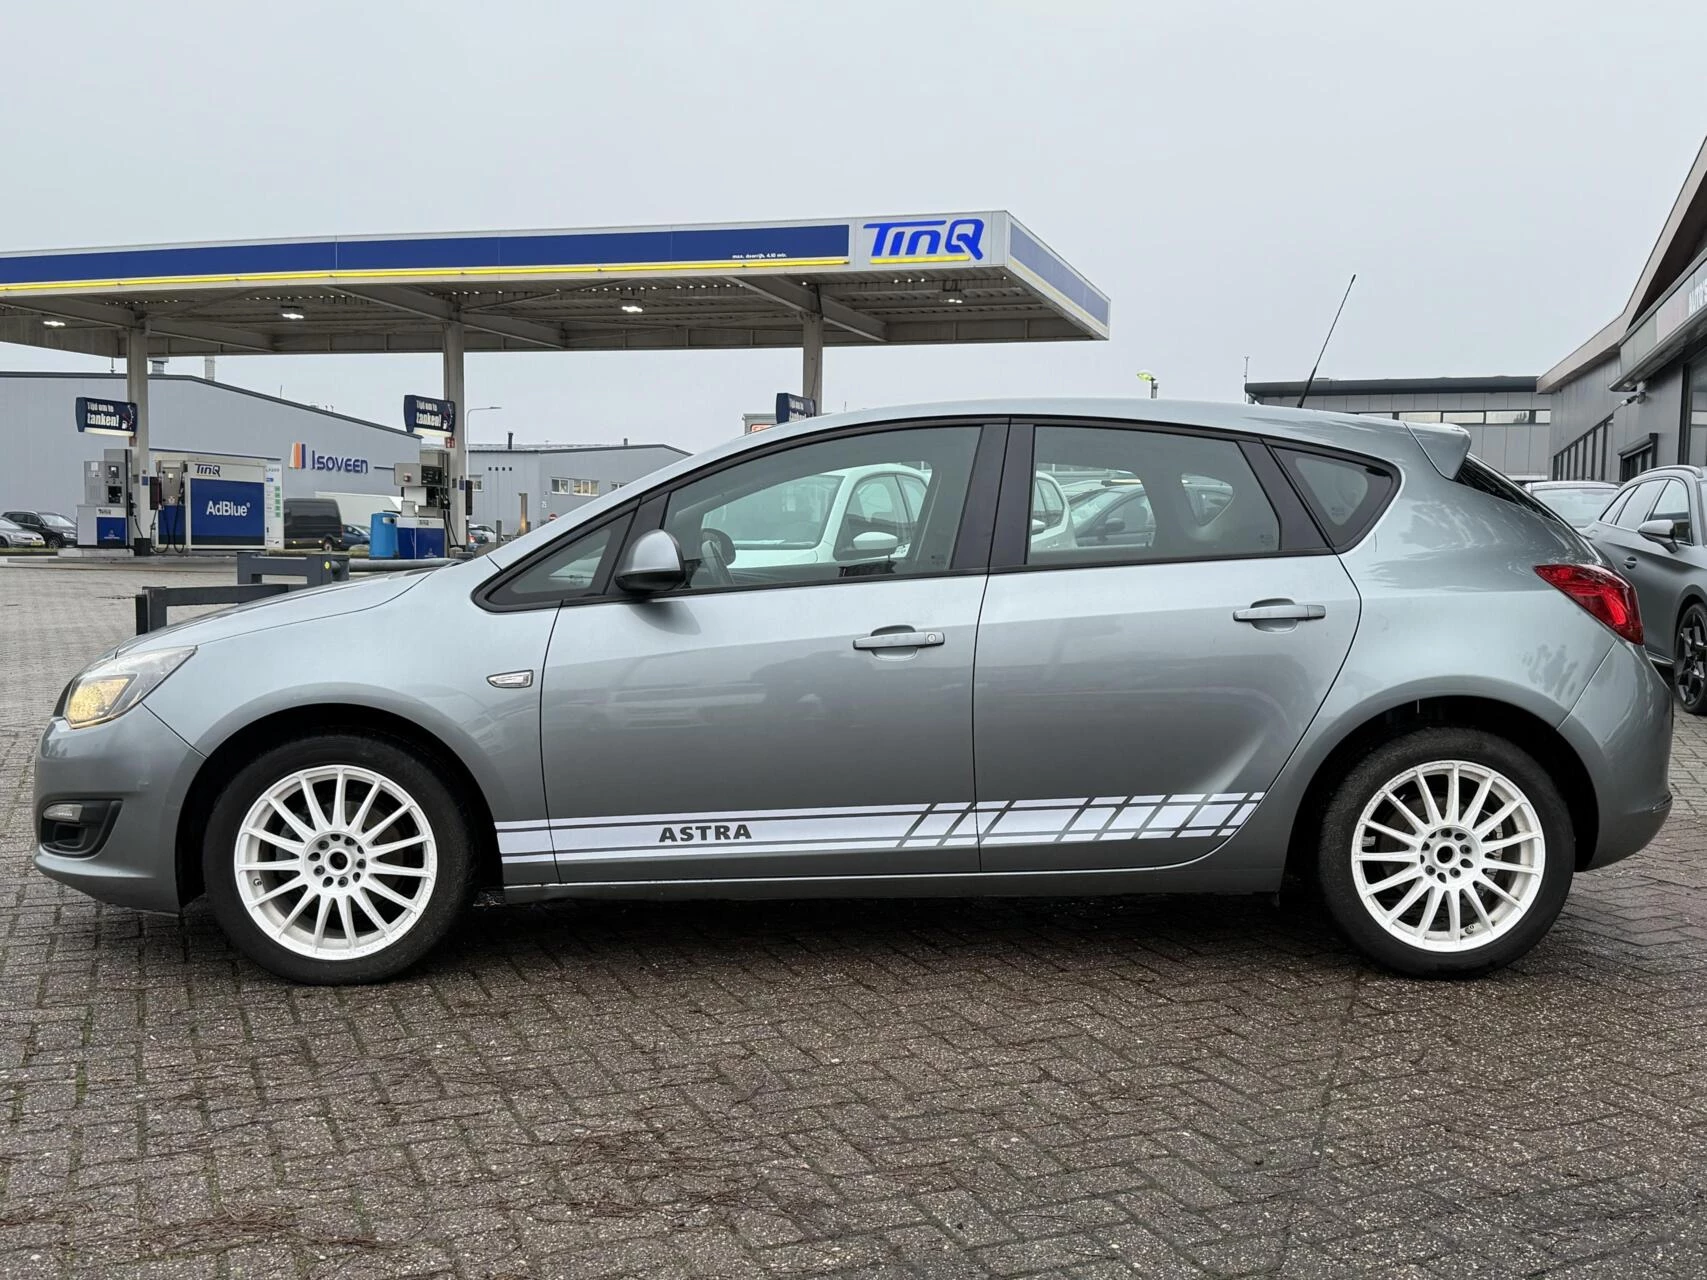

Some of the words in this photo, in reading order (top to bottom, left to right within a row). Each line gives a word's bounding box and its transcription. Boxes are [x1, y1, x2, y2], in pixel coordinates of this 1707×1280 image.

[863, 218, 984, 260] TinQ
[87, 412, 119, 427] tanken!
[416, 412, 442, 427] tanken!
[194, 463, 221, 477] TinQ
[658, 824, 752, 843] ASTRA
